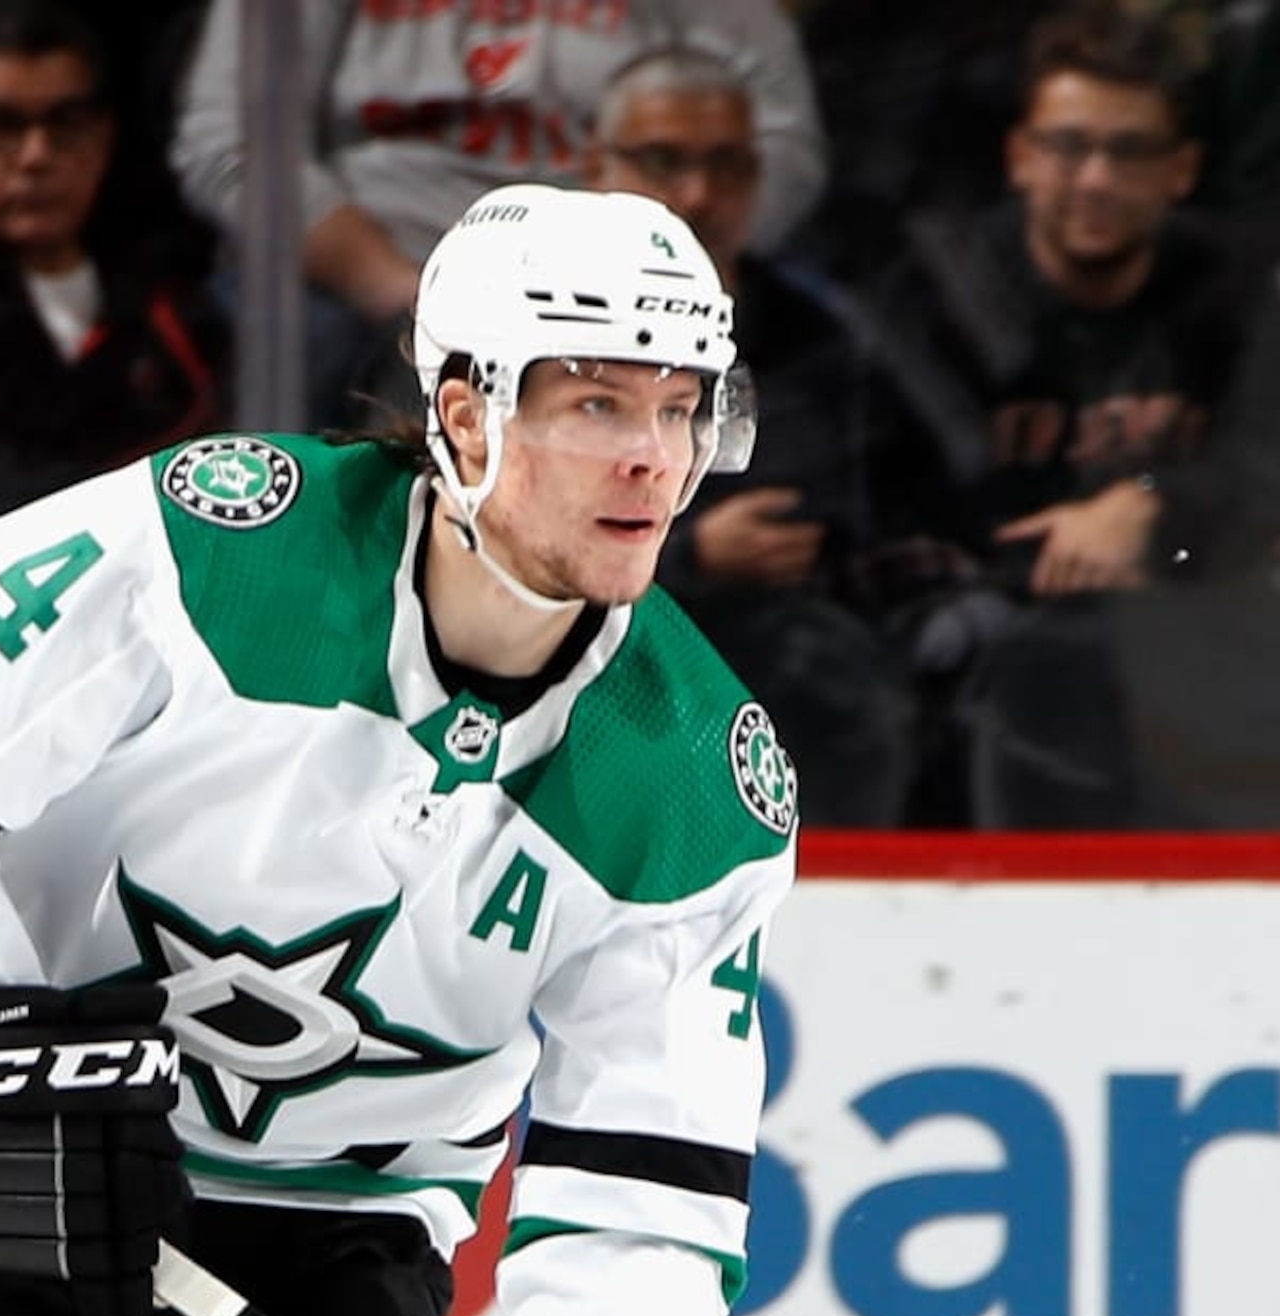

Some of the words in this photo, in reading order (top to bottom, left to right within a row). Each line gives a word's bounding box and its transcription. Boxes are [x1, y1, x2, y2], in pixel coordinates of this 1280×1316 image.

[634, 295, 712, 319] CCM
[469, 849, 548, 952] A
[710, 925, 762, 1041] 4
